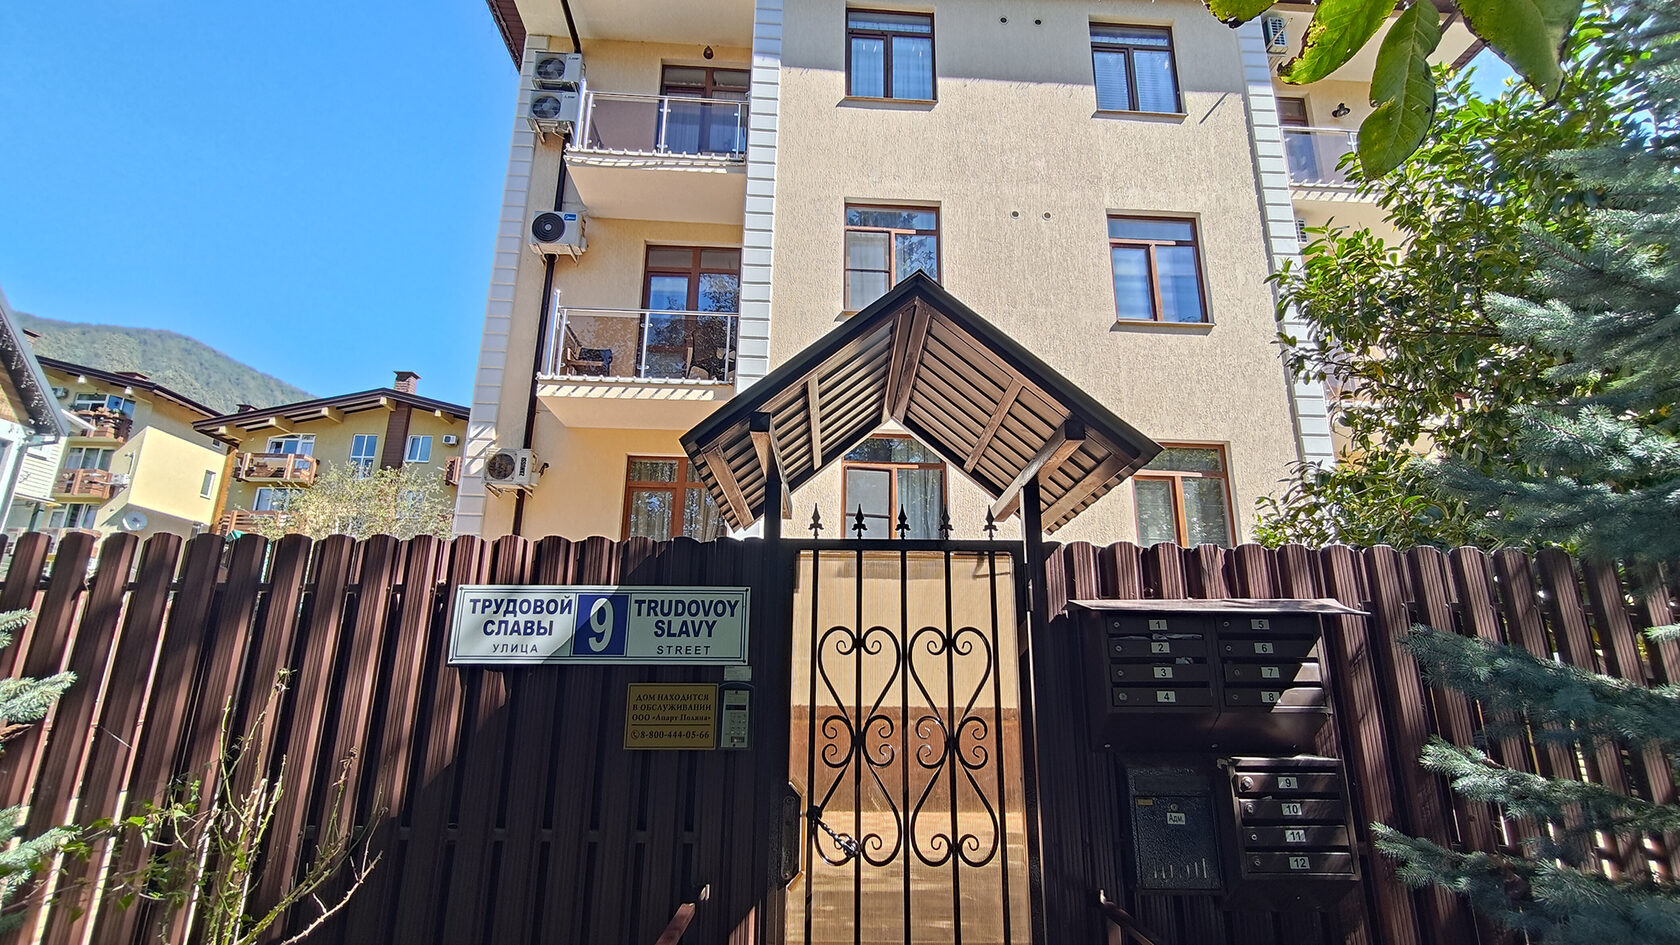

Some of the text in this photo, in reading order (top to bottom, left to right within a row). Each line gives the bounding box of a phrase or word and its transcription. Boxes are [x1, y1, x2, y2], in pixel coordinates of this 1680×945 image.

[469, 595, 573, 617] ТРУДОВОЙ
[634, 599, 740, 618] TRUDOVOY
[483, 619, 554, 636] СЛАВЫ
[588, 597, 614, 652] 9
[653, 619, 717, 638] SLAVY
[1155, 620, 1161, 629] 1
[1258, 620, 1264, 629] 5
[492, 644, 538, 654] УЛИЦА
[656, 645, 711, 655] STREET
[1158, 643, 1164, 652] 2
[1261, 643, 1268, 653] 6
[1160, 668, 1167, 677] 3
[1267, 668, 1273, 677] 7
[1163, 692, 1170, 701] 4
[1268, 692, 1275, 702] 8
[640, 703, 712, 712] ОБСЛУЖИВАНИИ
[632, 713, 651, 721] ООО
[640, 730, 710, 739] 8-800-444-05-66
[1285, 778, 1292, 788] 9
[1287, 804, 1298, 815] 10
[1290, 831, 1301, 841] 11
[1293, 858, 1306, 868] 12
